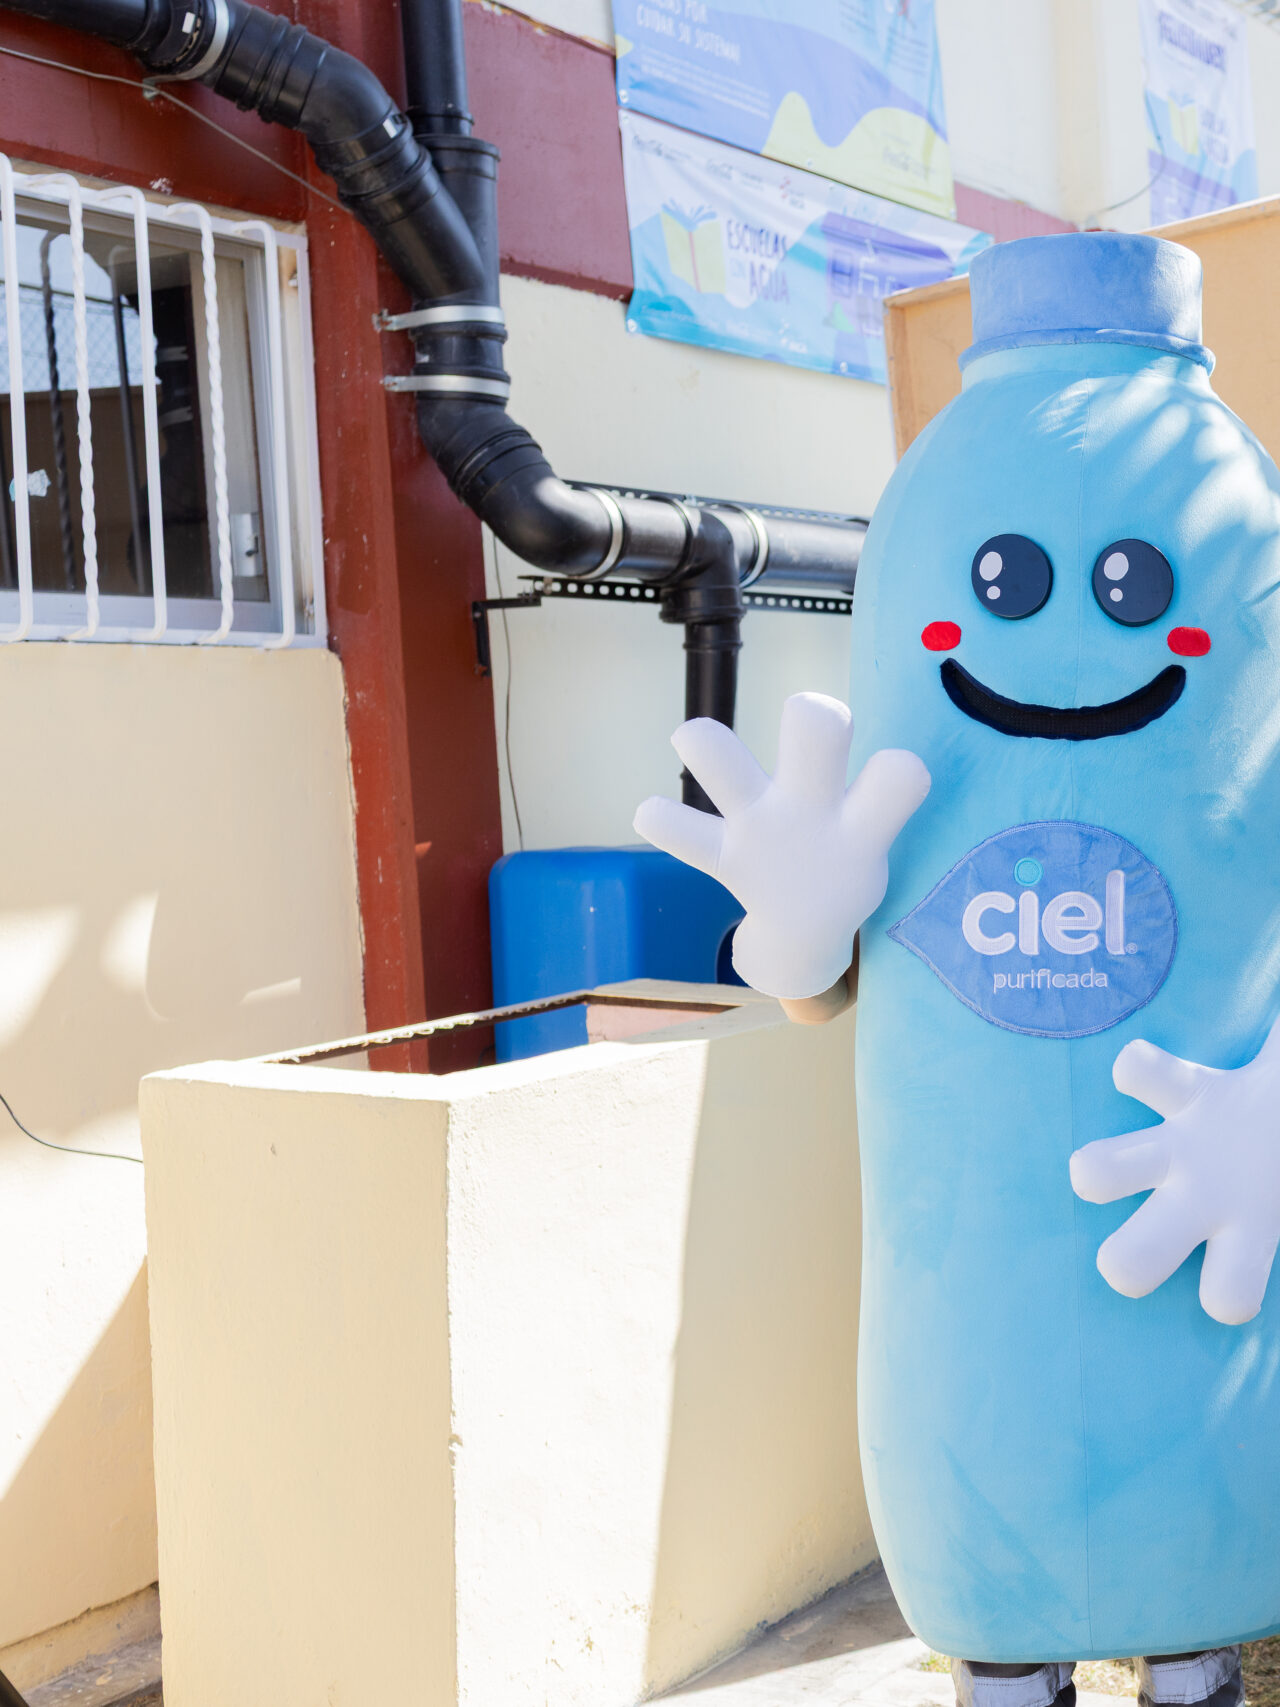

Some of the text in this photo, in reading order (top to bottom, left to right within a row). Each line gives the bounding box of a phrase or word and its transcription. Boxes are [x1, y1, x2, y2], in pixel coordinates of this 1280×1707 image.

[726, 219, 788, 262] ESCUELAS
[749, 261, 790, 303] AGUA
[993, 968, 1108, 994] purificada
